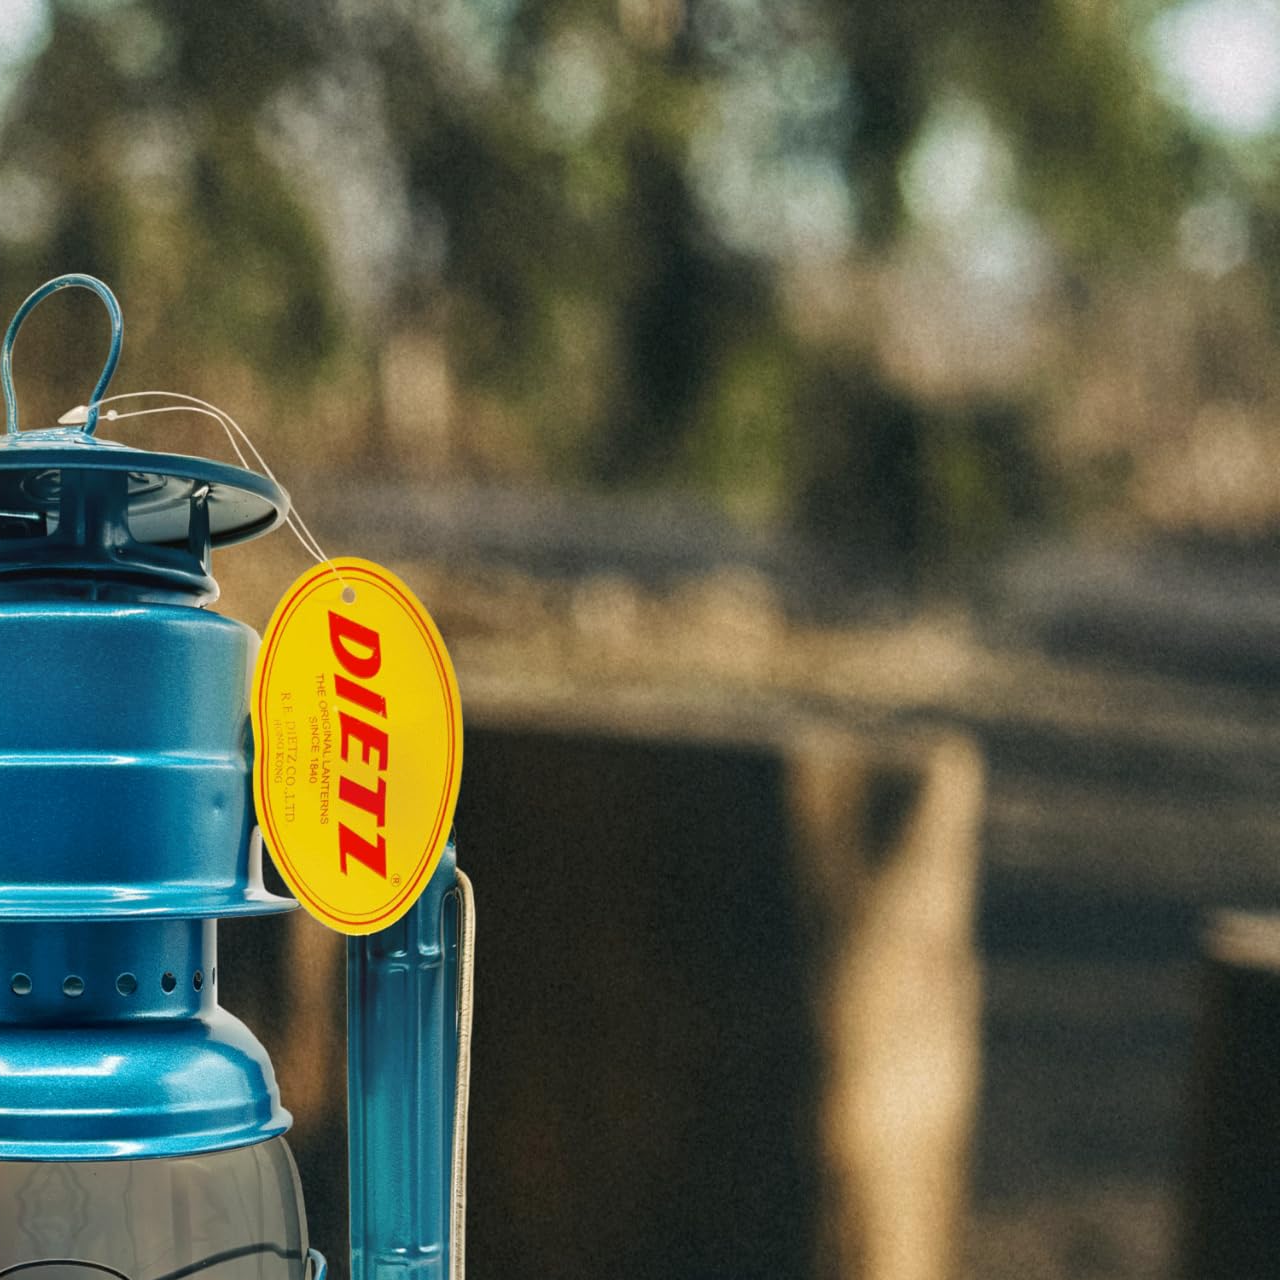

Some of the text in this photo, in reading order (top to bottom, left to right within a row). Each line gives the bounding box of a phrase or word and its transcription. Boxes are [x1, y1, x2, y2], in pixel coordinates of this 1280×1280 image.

[273, 752, 284, 784] KONG
[285, 720, 298, 764] DIETZ
[308, 716, 319, 784] SINCE 1840
[315, 672, 332, 825] THE ORIGINAL LANTERNS
[328, 611, 388, 878] DIETZ
